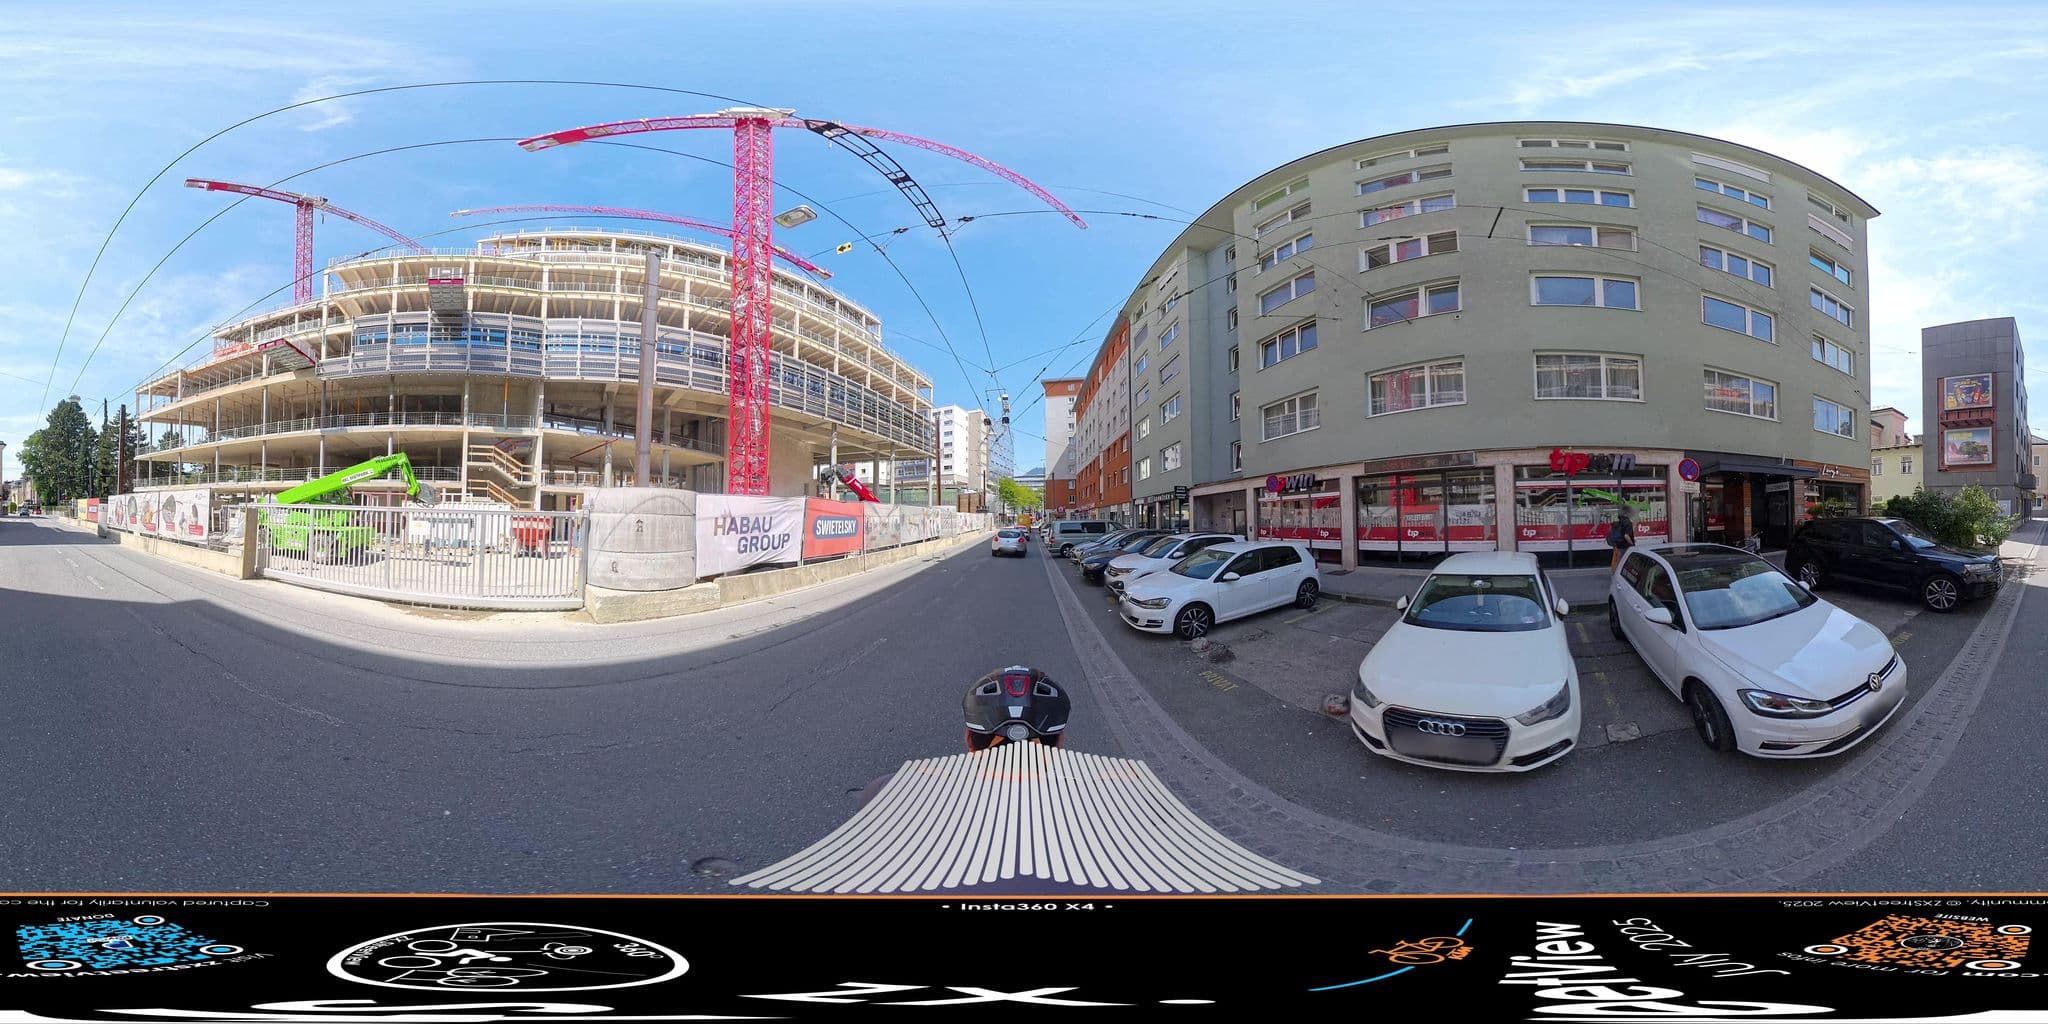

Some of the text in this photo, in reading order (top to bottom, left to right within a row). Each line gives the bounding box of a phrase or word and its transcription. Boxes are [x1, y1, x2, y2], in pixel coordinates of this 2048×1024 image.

[1549, 448, 1636, 476] tipwin
[714, 516, 772, 537] HABAU
[816, 519, 857, 536] SWIETELSKY
[738, 533, 790, 554] GROUP
